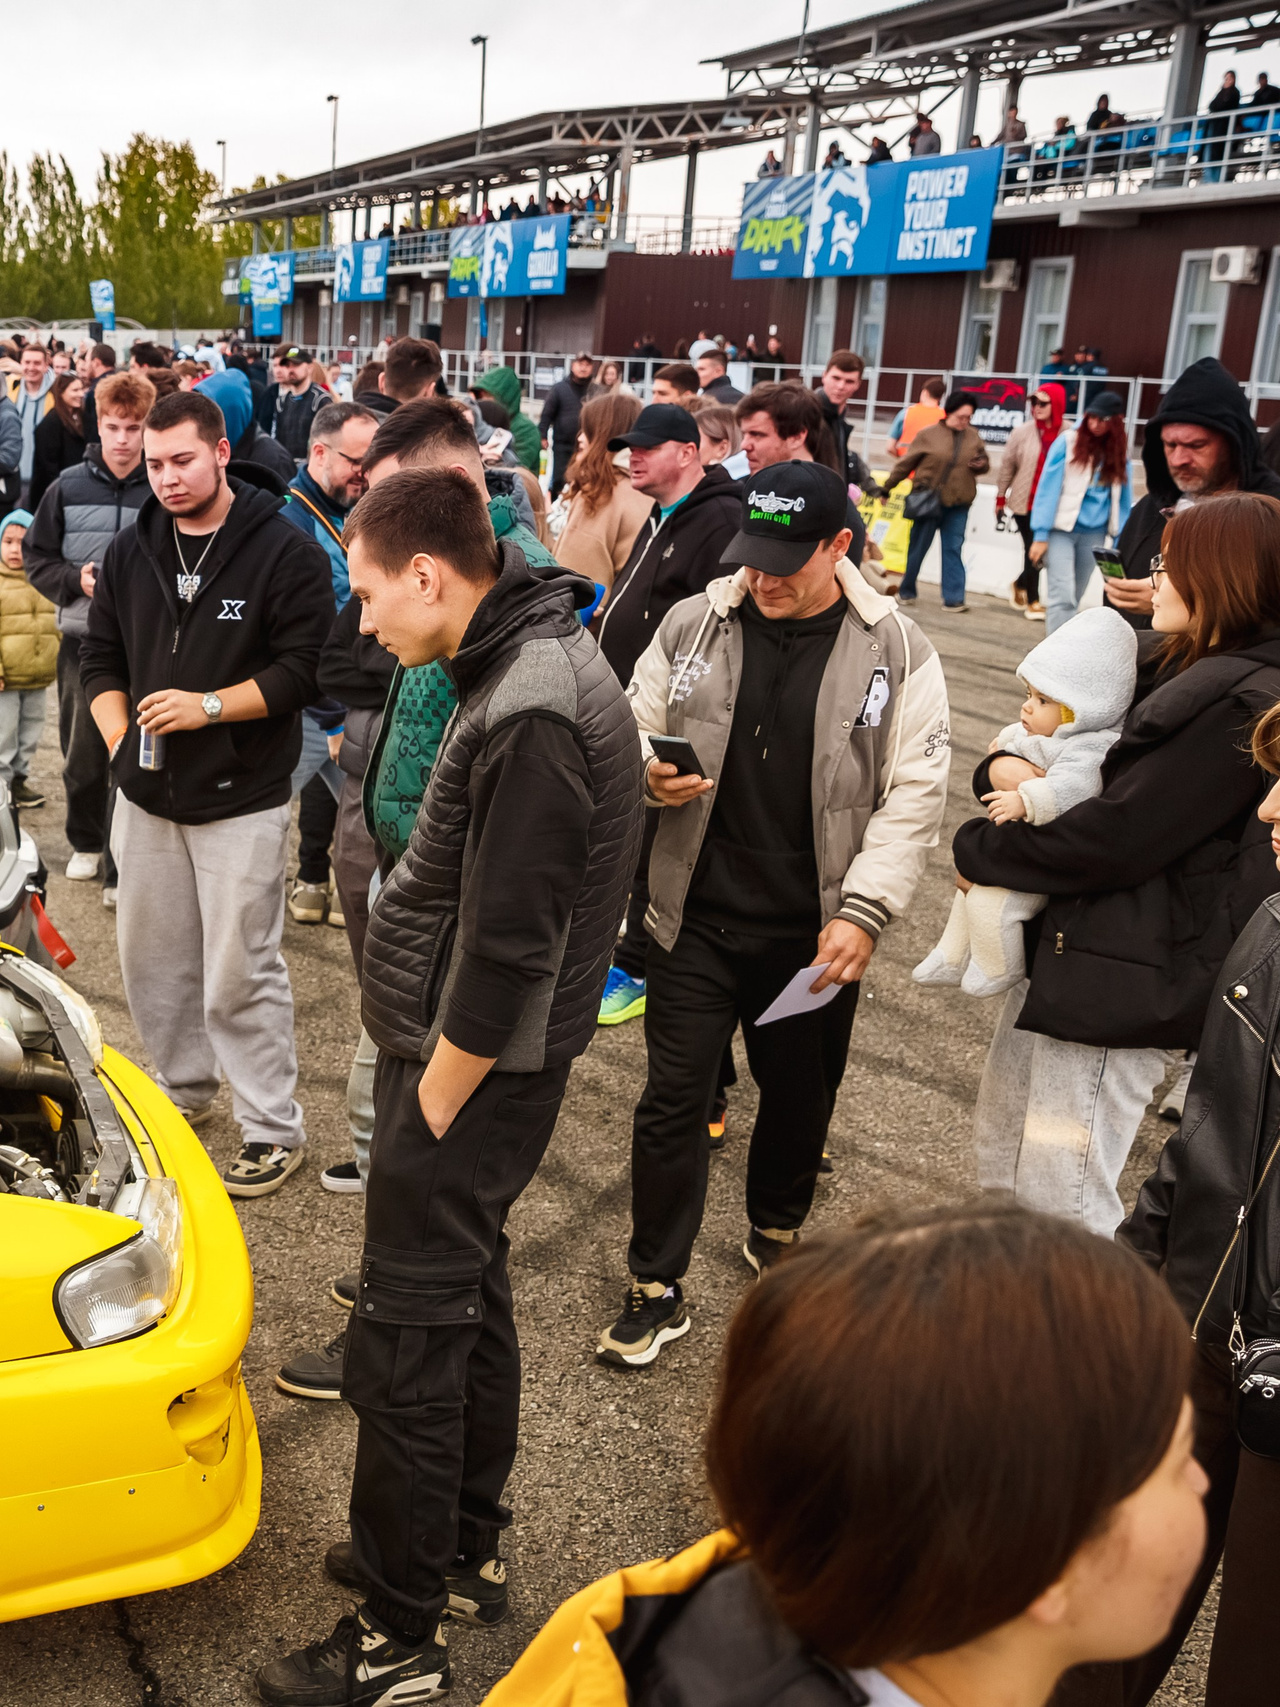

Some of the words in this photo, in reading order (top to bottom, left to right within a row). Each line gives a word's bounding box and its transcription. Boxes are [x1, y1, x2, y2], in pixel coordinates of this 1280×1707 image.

[905, 165, 969, 202] POWER
[904, 198, 949, 231] YOUR
[896, 226, 977, 261] INSTINCT
